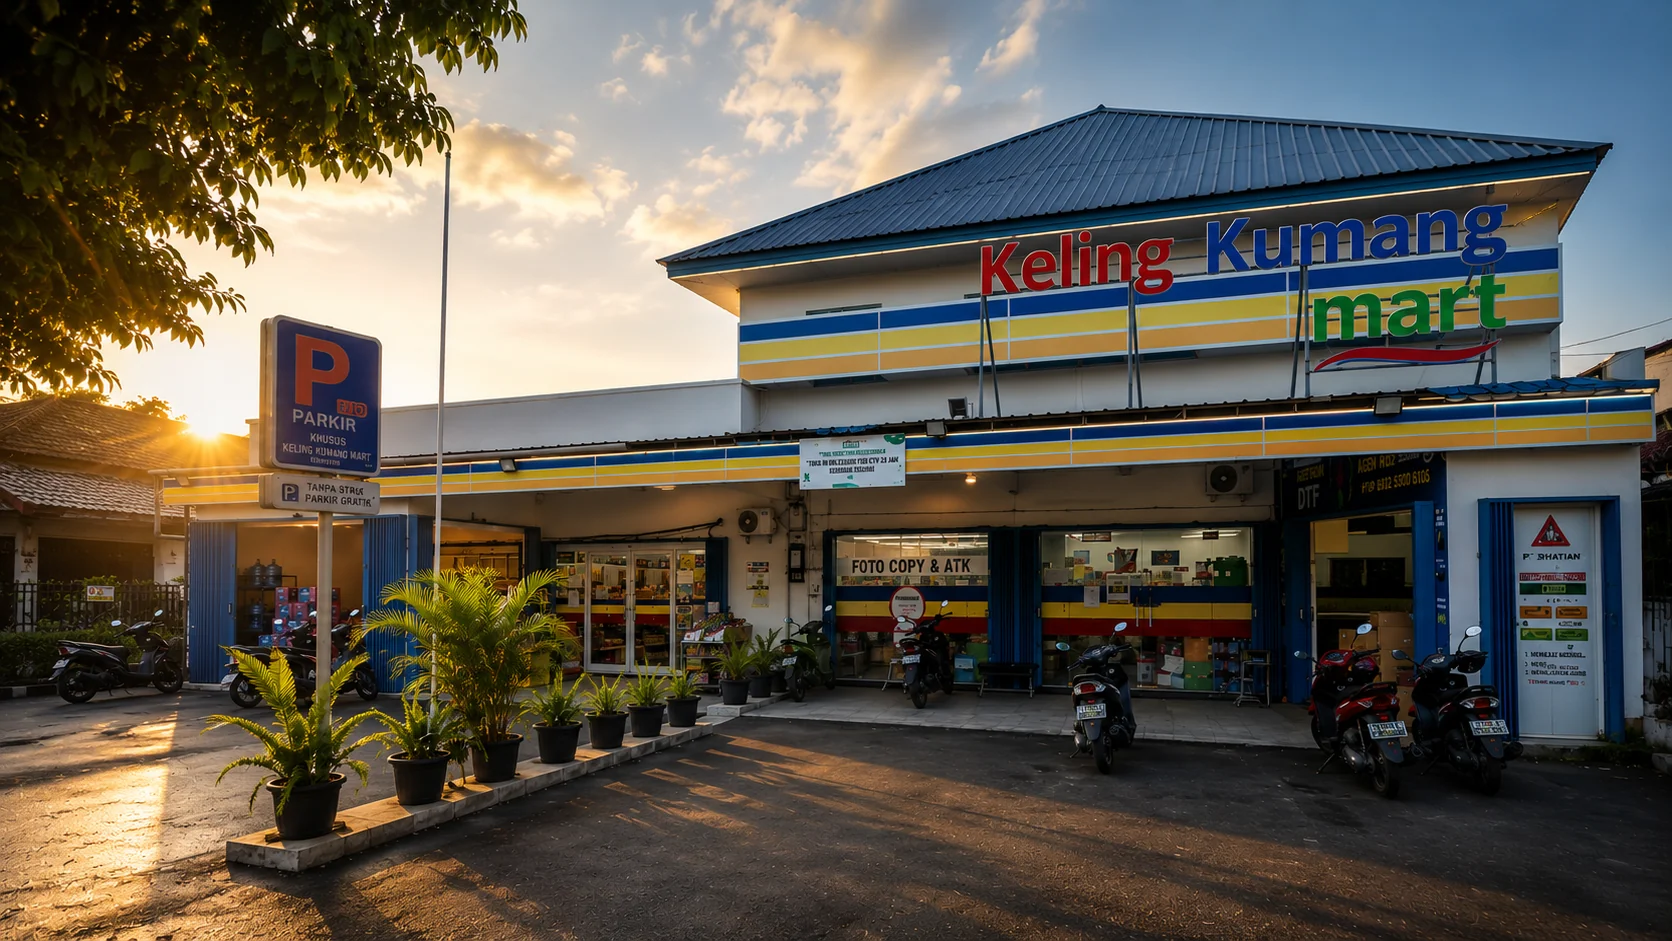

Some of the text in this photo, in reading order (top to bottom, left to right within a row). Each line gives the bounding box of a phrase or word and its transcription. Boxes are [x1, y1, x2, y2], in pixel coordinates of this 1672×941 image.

[980, 204, 1508, 296] Keling Kumang
[1313, 274, 1507, 342] mart
[295, 333, 350, 407] P
[292, 408, 356, 433] PARKIR
[282, 443, 313, 455] KELING
[285, 485, 296, 500] P
[307, 482, 337, 493] TANPA
[1298, 484, 1320, 510] DTF
[305, 494, 338, 504] PARKIR
[852, 558, 971, 573] FOTO COPY & ATK
